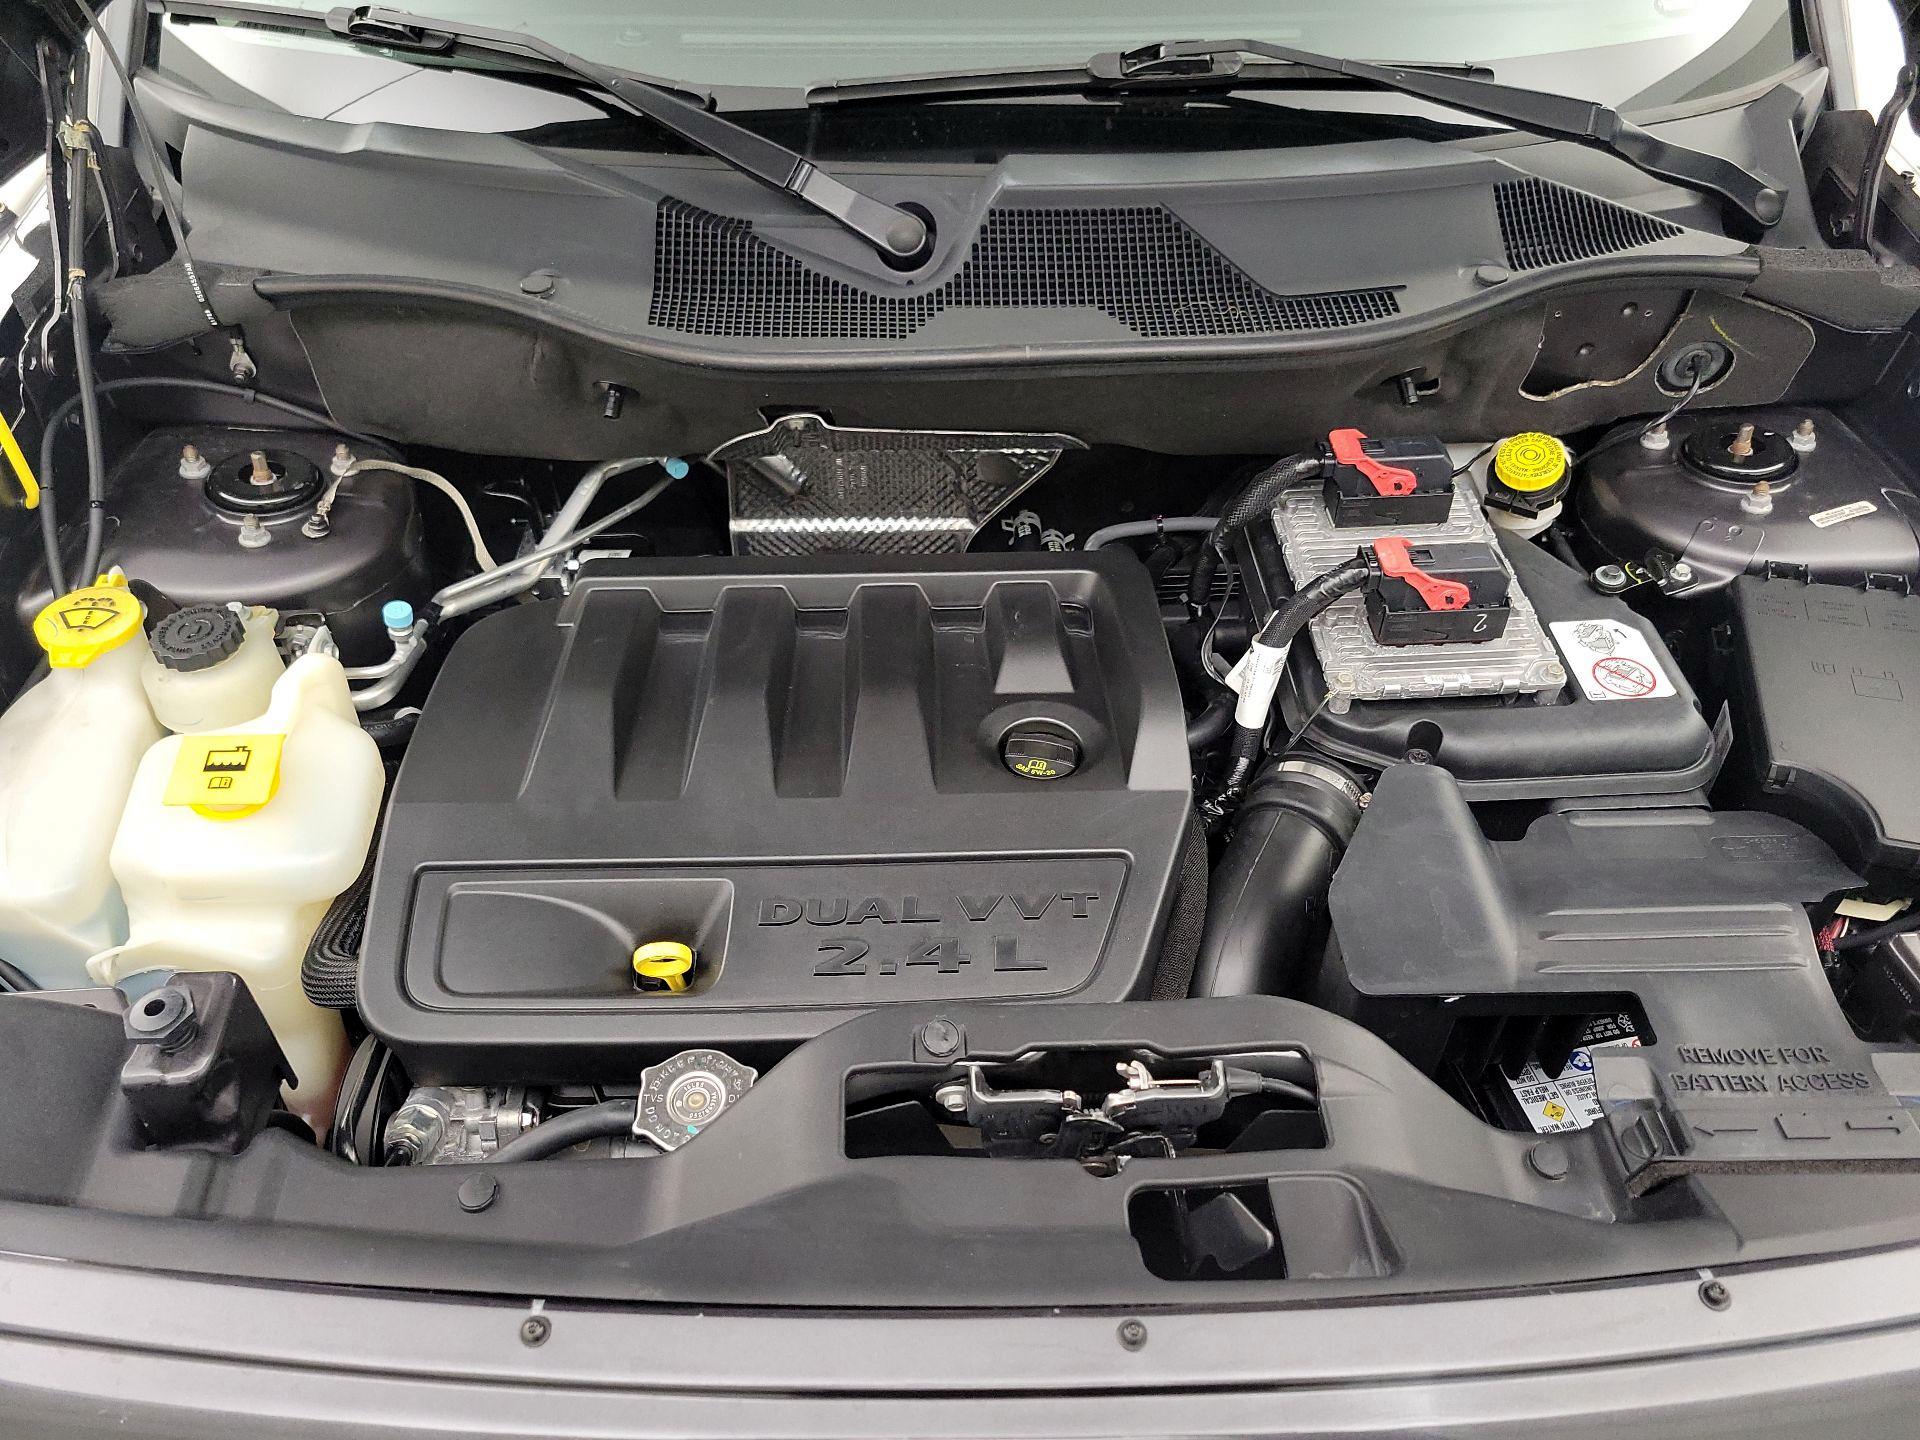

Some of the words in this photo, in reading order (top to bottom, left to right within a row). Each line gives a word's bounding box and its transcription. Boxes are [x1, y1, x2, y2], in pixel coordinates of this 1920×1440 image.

[1472, 613, 1488, 633] 2
[1015, 763, 1030, 773] SAE
[757, 896, 941, 927] DUAL
[955, 892, 1100, 922] VVT
[1677, 1045, 1778, 1065] REMOVE
[1778, 1045, 1831, 1065] FOR
[1670, 1072, 1770, 1092] BATTERY
[1777, 1071, 1871, 1092] ACCESS
[1520, 1087, 1535, 1098] FAST
[1535, 1085, 1549, 1095] HELP
[1550, 1091, 1559, 1099] GET
[643, 1094, 664, 1103] TVS
[1521, 1092, 1549, 1105] MEDICAL
[1584, 1107, 1603, 1116] FURIC
[1560, 1120, 1577, 1131] WITH
